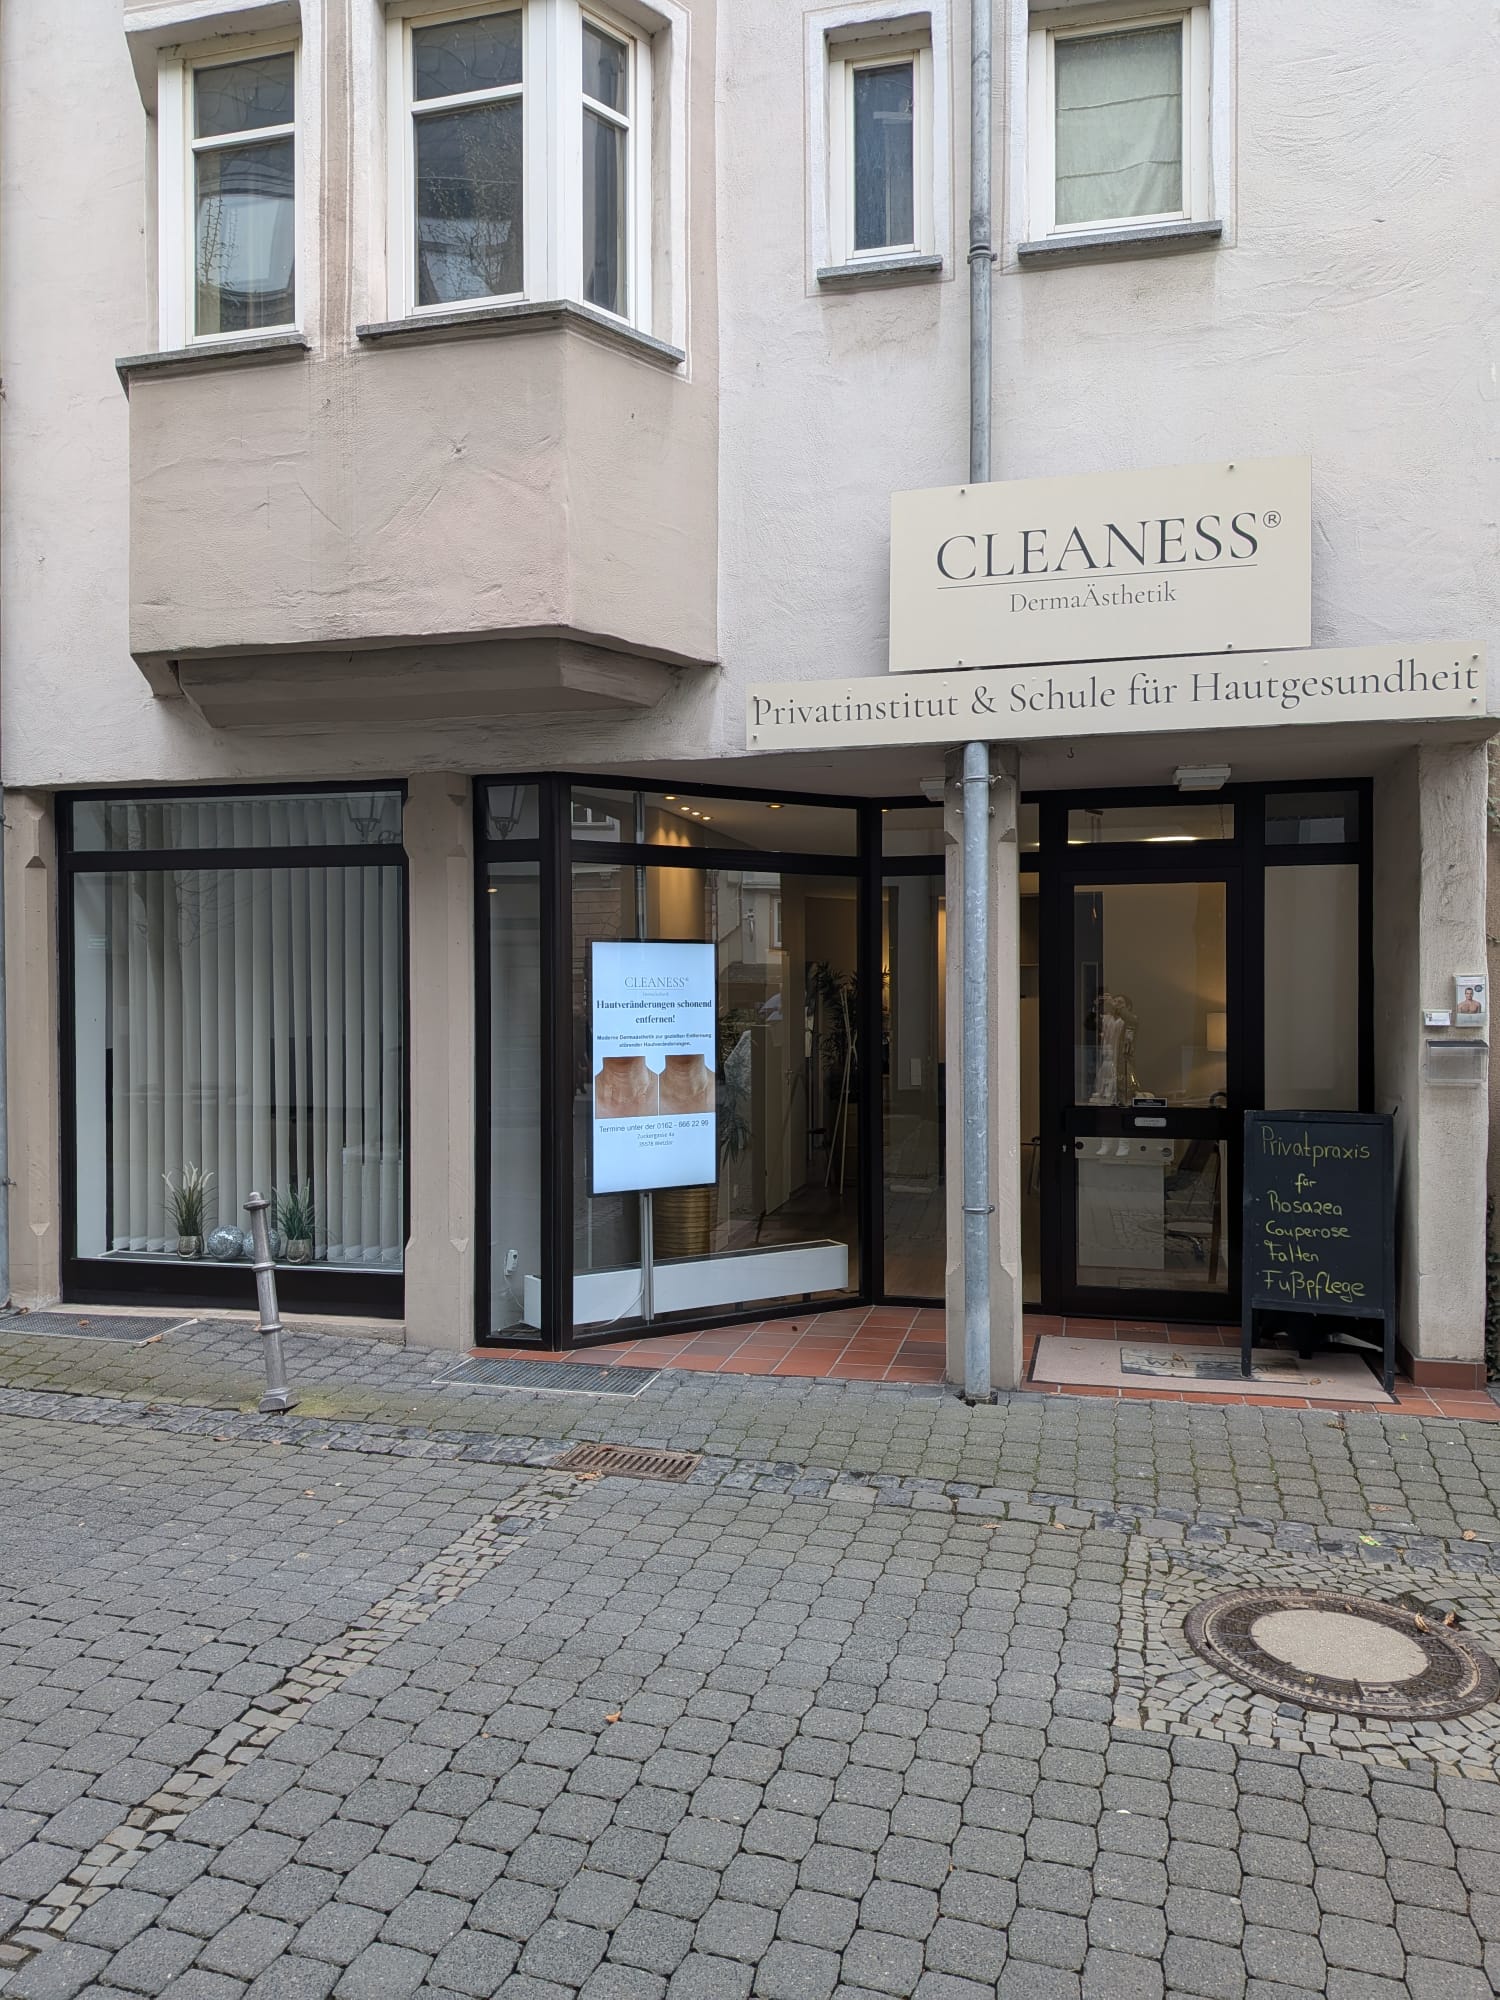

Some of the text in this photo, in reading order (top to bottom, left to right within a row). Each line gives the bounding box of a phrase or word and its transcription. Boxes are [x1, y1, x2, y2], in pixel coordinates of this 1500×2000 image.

[1009, 580, 1177, 613] DermaÄsthetik
[754, 658, 1480, 726] Privatinstitut & Schule für Hautgesundheit
[596, 1000, 712, 1010] Hautveränderungen schonend
[635, 1015, 676, 1024] entfernen!
[600, 1125, 626, 1133] Termine
[626, 1123, 643, 1131] unter
[656, 1121, 673, 1130] 0162
[691, 1120, 700, 1128] 22
[1261, 1125, 1370, 1167] Privatpraxis
[1267, 1190, 1343, 1216] Rosazea
[1265, 1220, 1351, 1240] Couperose
[1264, 1240, 1319, 1263] Falten
[1262, 1269, 1366, 1303] Fußpflege
